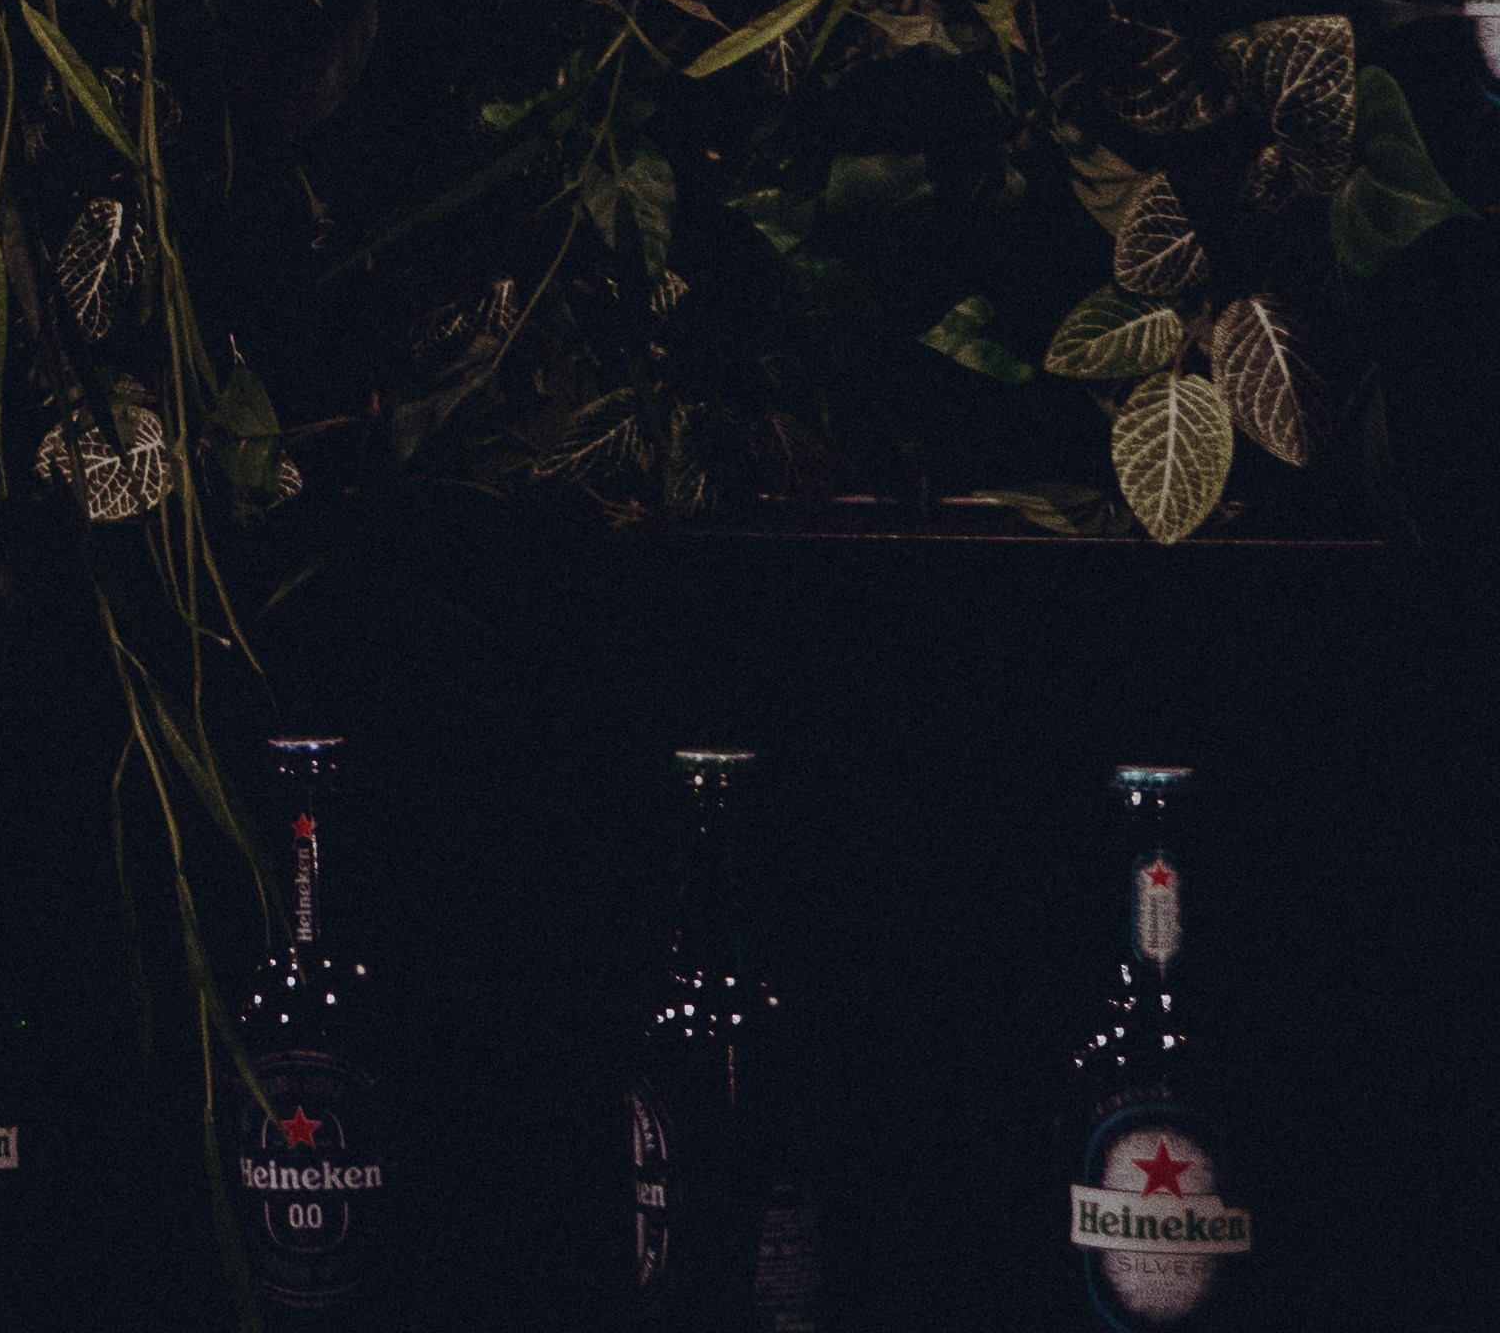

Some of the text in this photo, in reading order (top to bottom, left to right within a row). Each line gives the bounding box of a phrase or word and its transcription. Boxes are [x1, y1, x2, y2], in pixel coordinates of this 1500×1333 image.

[294, 847, 313, 942] Heineken
[240, 1156, 383, 1191] Heineken
[1078, 1198, 1245, 1242] Heineken
